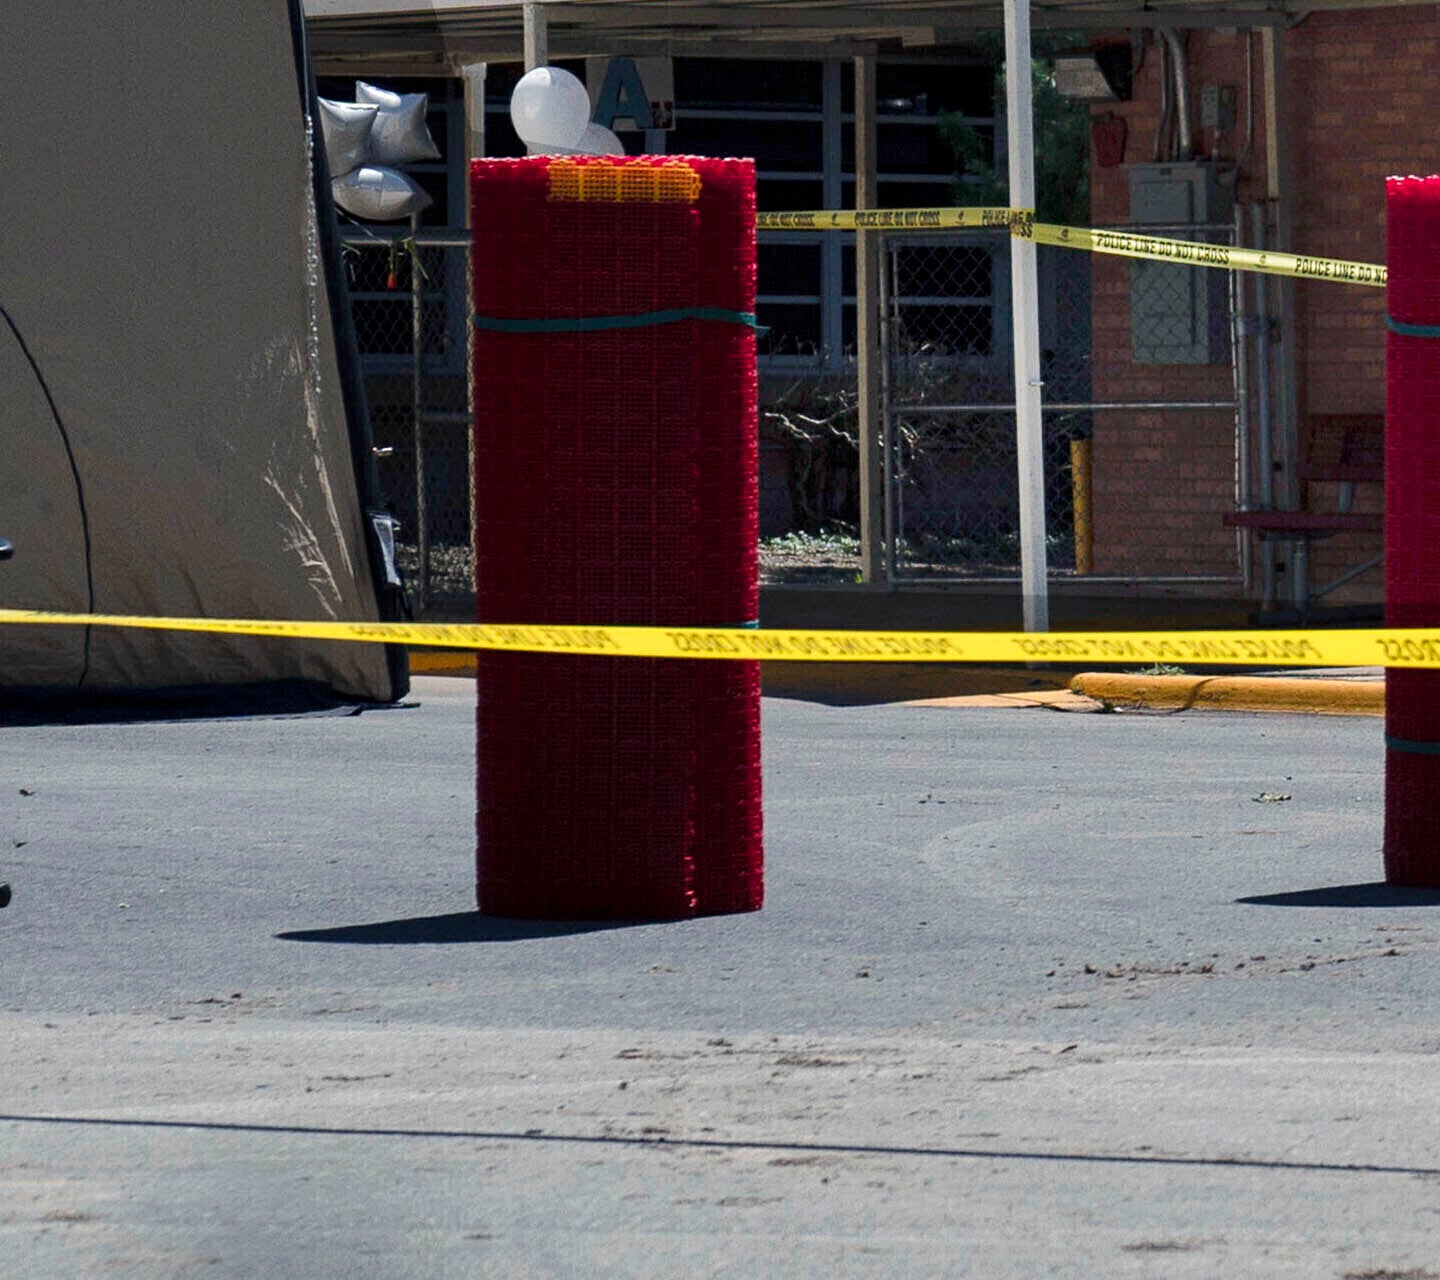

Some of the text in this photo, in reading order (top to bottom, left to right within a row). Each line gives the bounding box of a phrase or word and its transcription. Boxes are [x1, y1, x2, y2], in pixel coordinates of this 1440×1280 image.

[1096, 233, 1230, 264] POLICE LINE DO NOT CROSS
[1295, 258, 1387, 284] POLICE LINE DO NO
